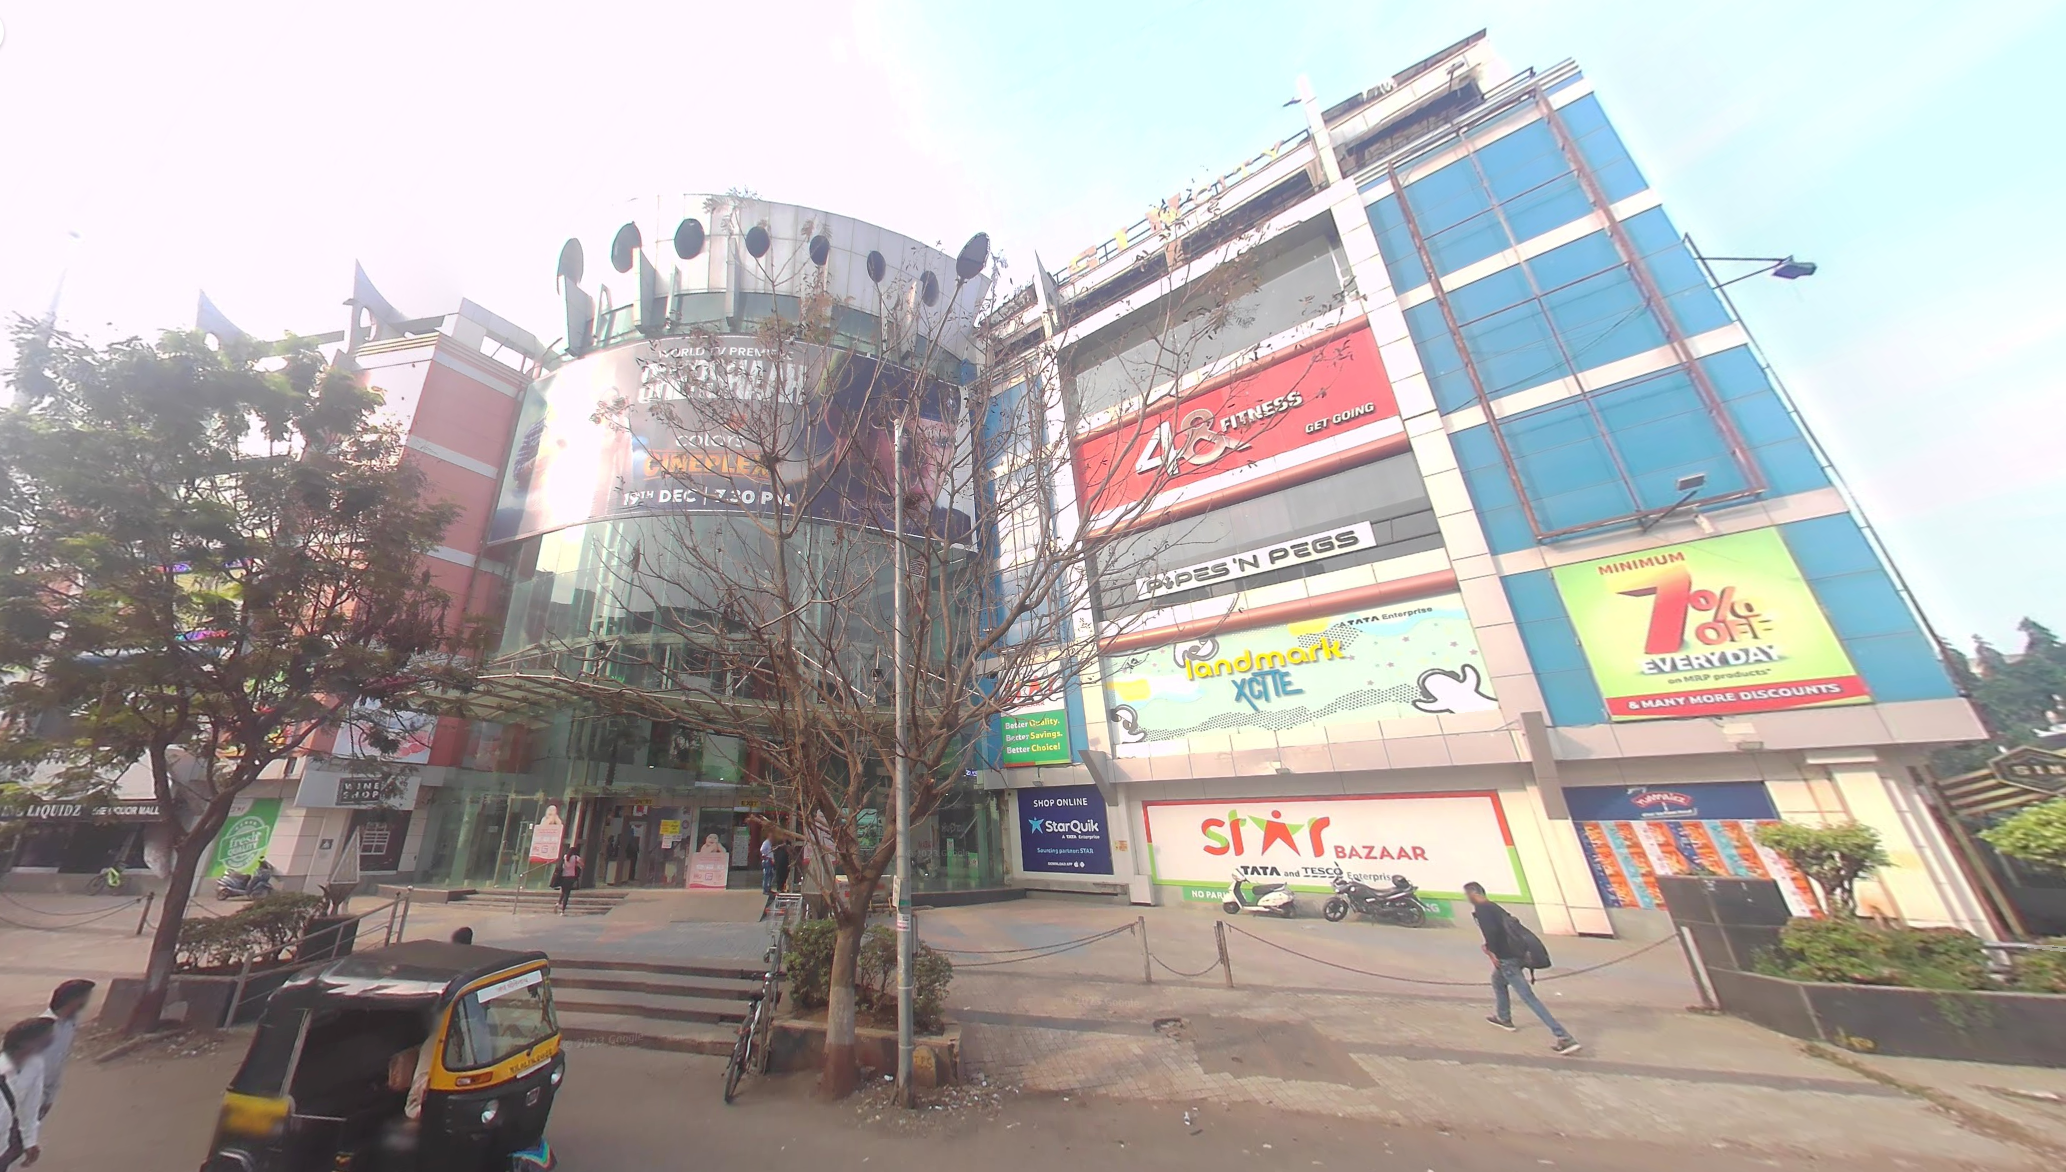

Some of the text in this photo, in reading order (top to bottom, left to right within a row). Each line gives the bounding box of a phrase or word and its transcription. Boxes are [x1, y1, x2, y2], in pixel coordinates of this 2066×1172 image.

[1219, 391, 1303, 433] FITNESS
[1304, 402, 1375, 434] GET GOING
[676, 429, 746, 448] colors
[643, 451, 771, 478] CINEPLEX
[658, 489, 697, 504] DEC
[1269, 530, 1360, 565] PEGS
[1597, 551, 1686, 576] MINIMUM
[1348, 615, 1380, 625] TATA
[1382, 606, 1433, 621] Enterprise
[1695, 615, 1775, 646] OFF
[1684, 674, 1710, 683] MRP
[1628, 683, 1843, 710] & MANY MORE DISCOUNTS
[1005, 721, 1028, 730] Better
[1006, 730, 1063, 742] Better Savings.
[1007, 742, 1060, 754] Better Choice!
[344, 782, 380, 790] WINE
[138, 806, 160, 815] MALL
[1033, 797, 1088, 808] SHOP ONLINE
[1045, 819, 1099, 834] StarQuik
[1334, 845, 1429, 861] BAZAAR
[1240, 865, 1392, 884] TATA and TESCO Enterpris
[1191, 890, 1204, 898] NO
